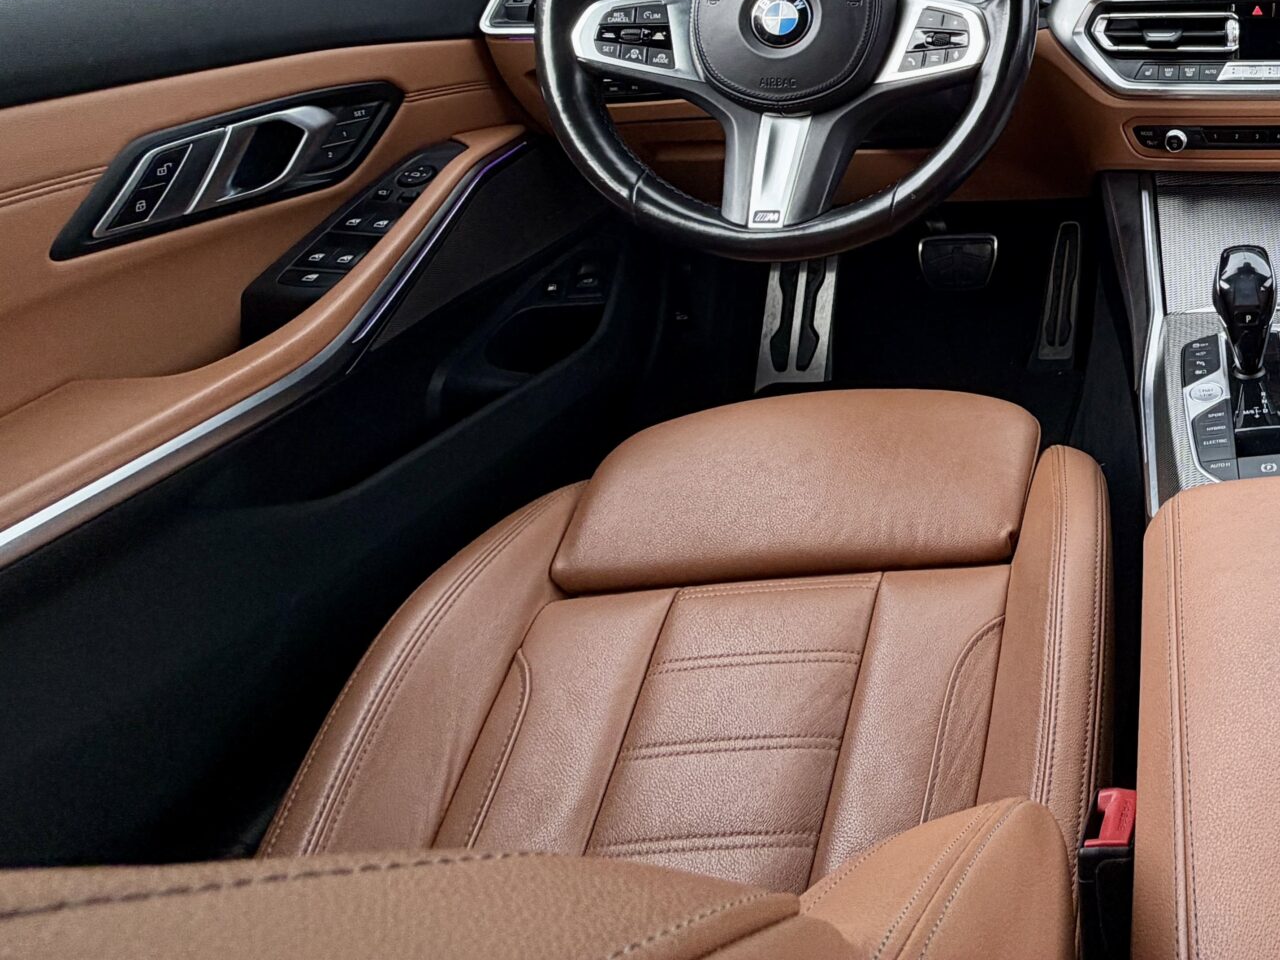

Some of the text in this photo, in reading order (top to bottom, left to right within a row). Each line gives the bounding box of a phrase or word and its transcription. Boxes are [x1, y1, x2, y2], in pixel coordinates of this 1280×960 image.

[759, 77, 798, 89] AIRBAG
[353, 109, 366, 117] SET
[1245, 314, 1252, 323] P
[1203, 438, 1228, 446] ELECTRIC
